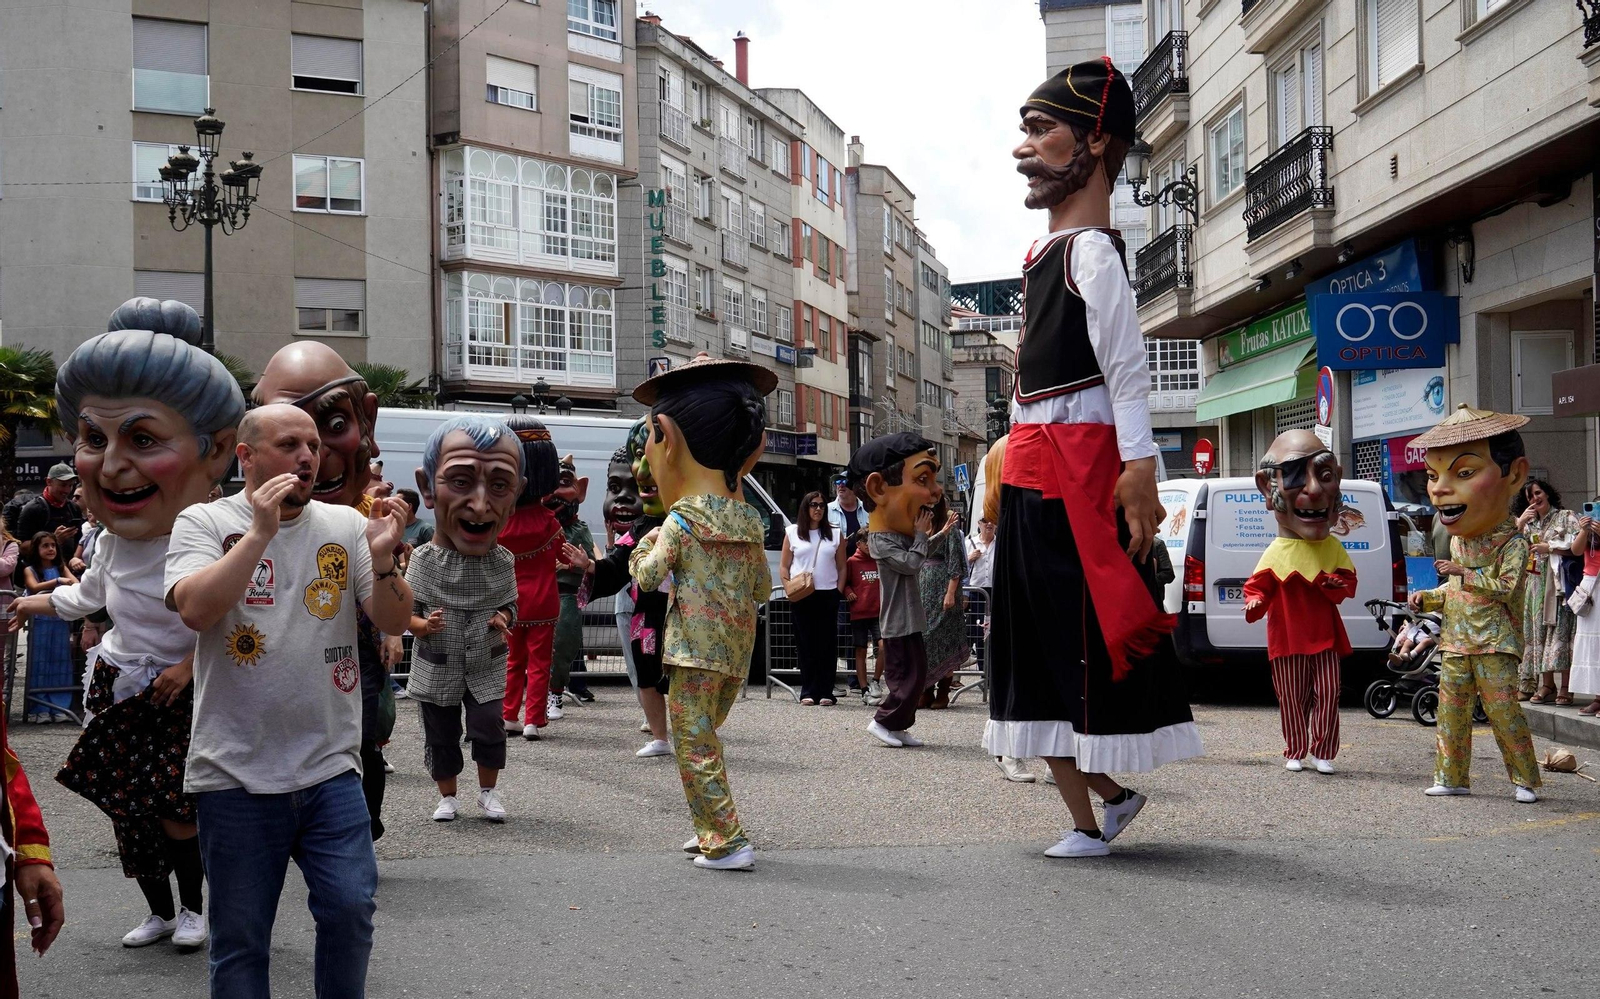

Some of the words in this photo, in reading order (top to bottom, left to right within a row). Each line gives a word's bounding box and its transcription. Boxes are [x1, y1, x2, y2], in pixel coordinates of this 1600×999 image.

[649, 189, 667, 348] MUEBLES
[1377, 259, 1386, 281] 3
[1241, 331, 1269, 355] Frutas
[1225, 494, 1266, 502] PULPE
[319, 546, 345, 558] SUNRISE
[311, 582, 334, 592] HAWAII
[249, 589, 271, 598] Replay
[1228, 589, 1246, 599] 62
